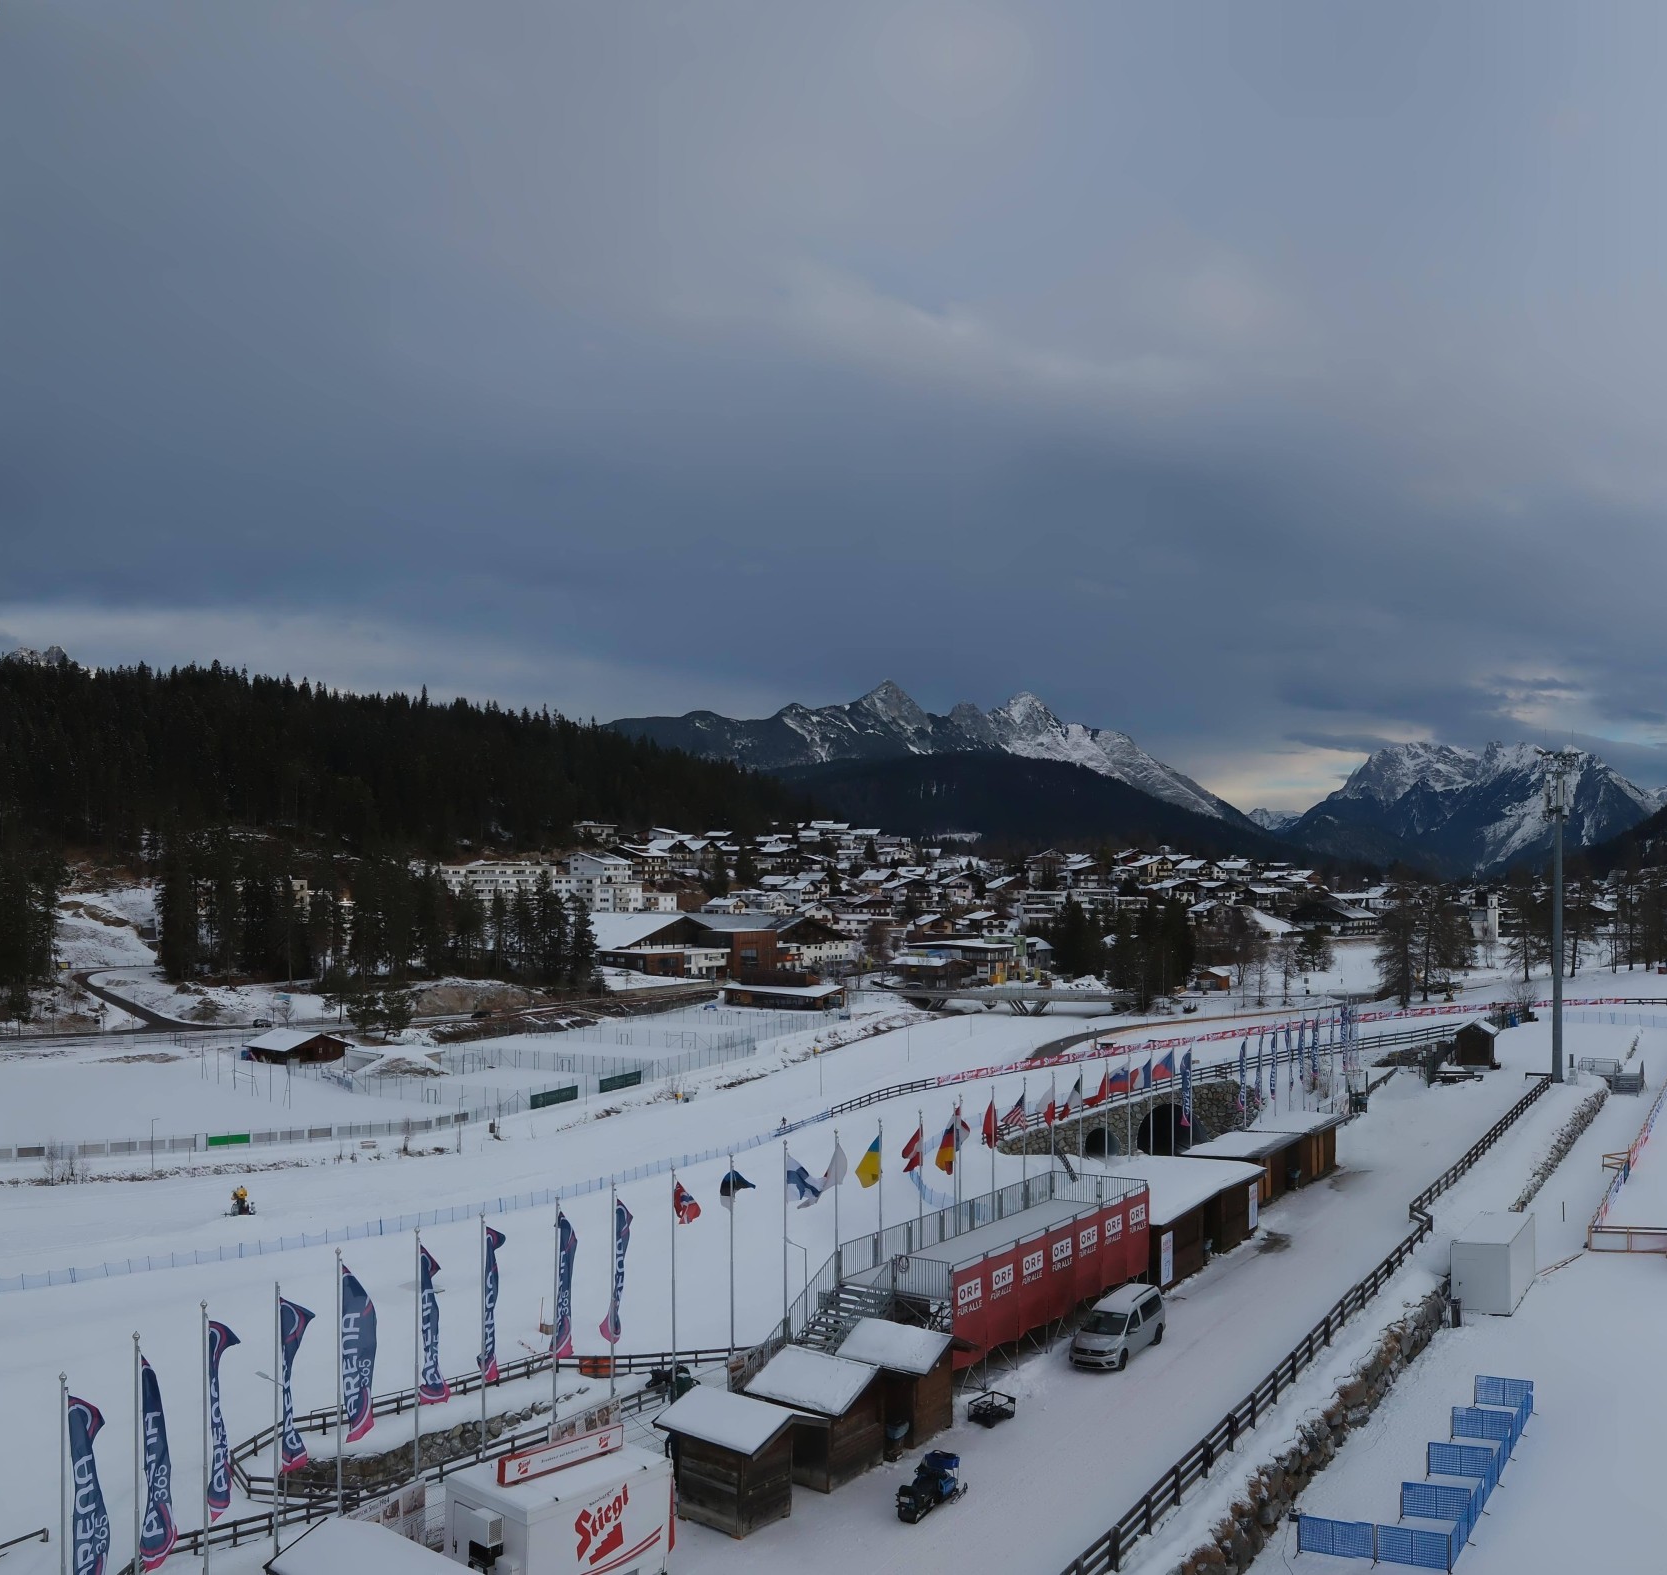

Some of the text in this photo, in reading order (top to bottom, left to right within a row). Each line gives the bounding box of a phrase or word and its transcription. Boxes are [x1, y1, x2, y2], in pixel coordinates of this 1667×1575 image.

[1130, 1207, 1144, 1221] ORF
[1107, 1218, 1121, 1233] ORF
[1081, 1230, 1096, 1245] ORF
[1054, 1242, 1070, 1257] ORF
[1024, 1255, 1042, 1271] ORF
[994, 1268, 1012, 1285] ORF
[959, 1282, 980, 1300] ORF
[342, 1313, 362, 1417] ARENA
[359, 1359, 371, 1388] 365
[154, 1464, 168, 1501] 365
[575, 1483, 629, 1562] Stiegl
[96, 1514, 108, 1555] 365
